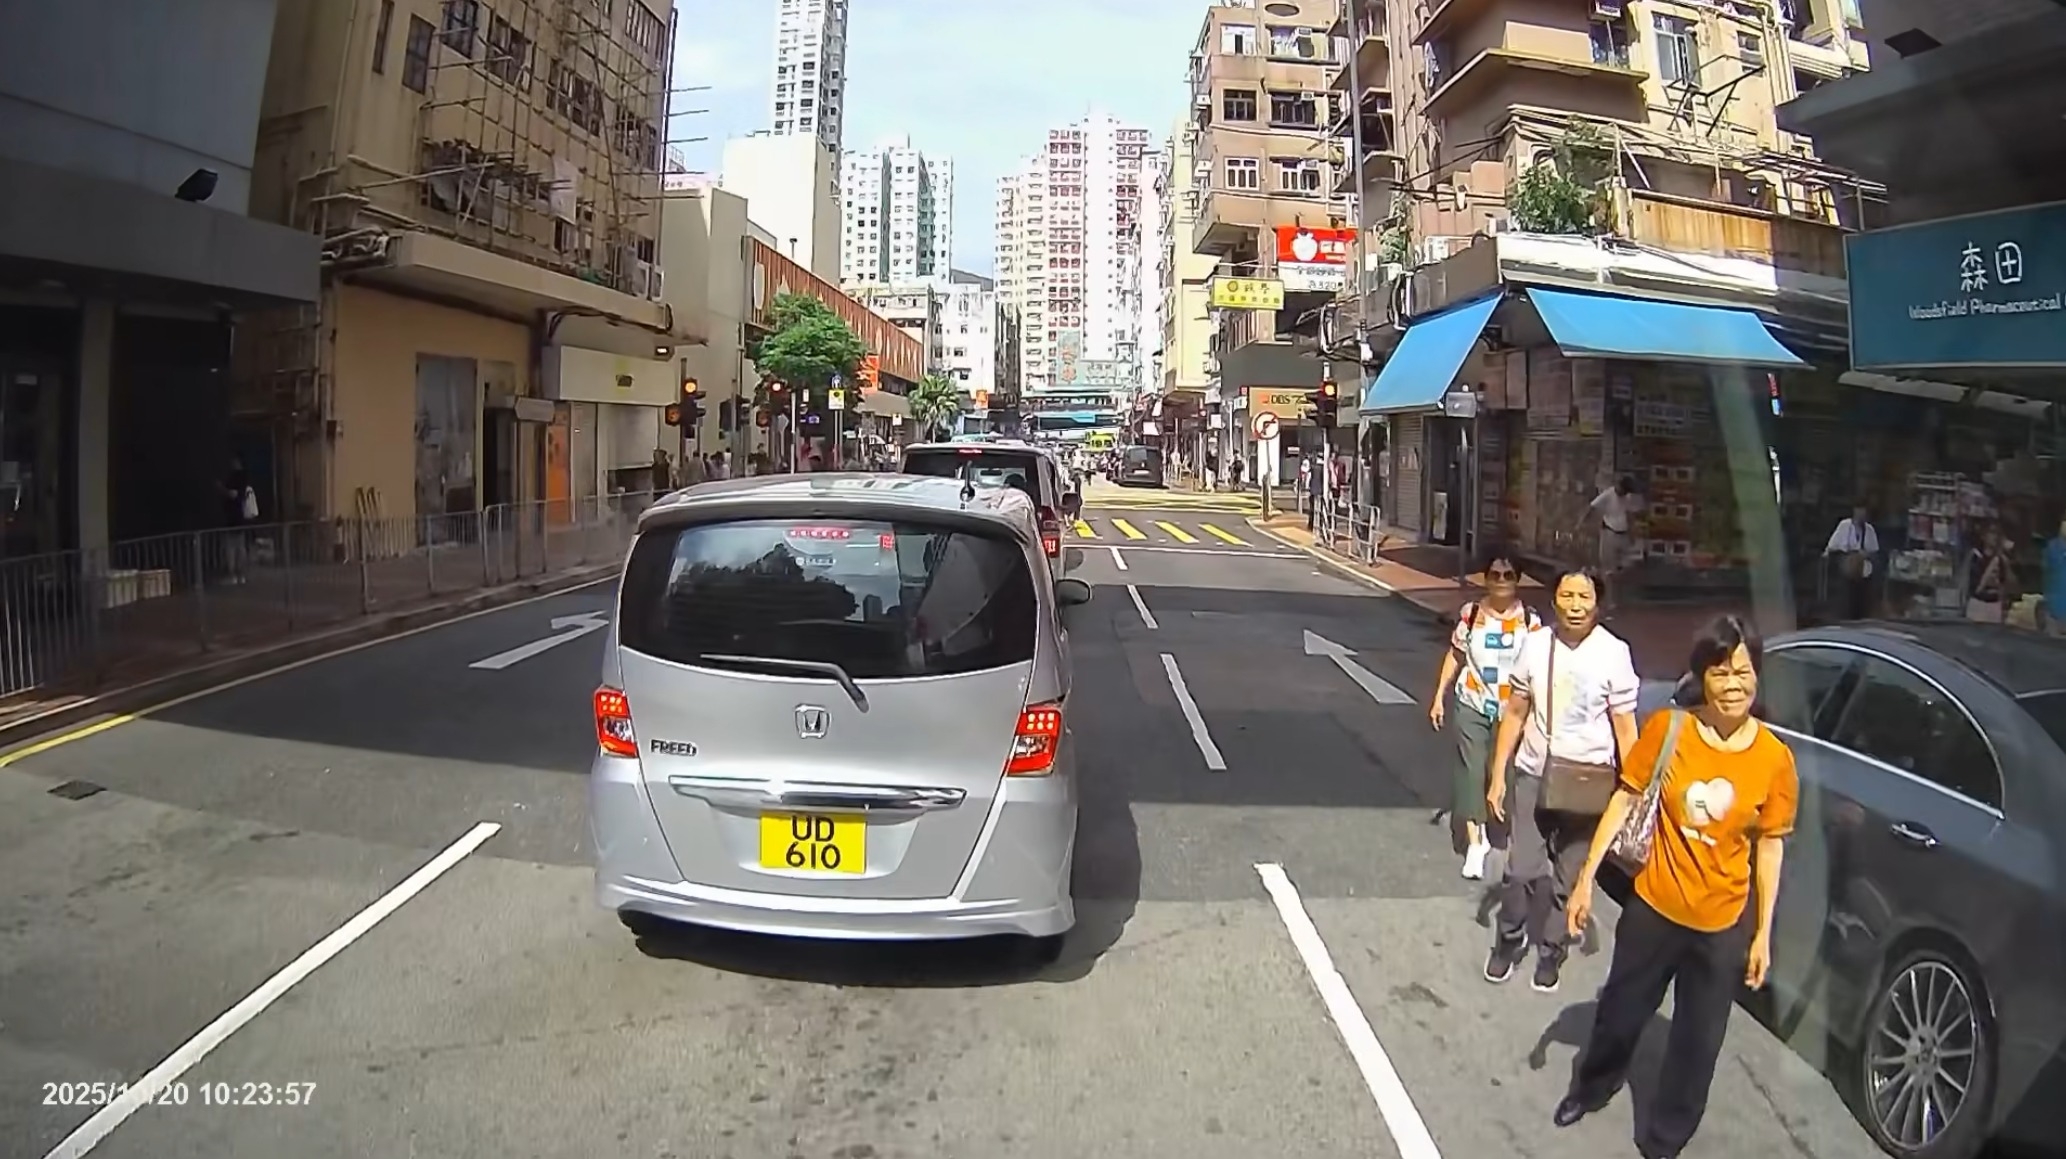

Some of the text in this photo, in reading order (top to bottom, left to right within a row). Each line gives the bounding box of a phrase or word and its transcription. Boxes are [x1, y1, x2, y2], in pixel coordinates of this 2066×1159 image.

[1960, 241, 2022, 292] 森田
[1970, 293, 2061, 315] Pharmaceutical
[651, 739, 697, 756] FREED
[791, 816, 835, 841] UD
[785, 843, 841, 870] 610
